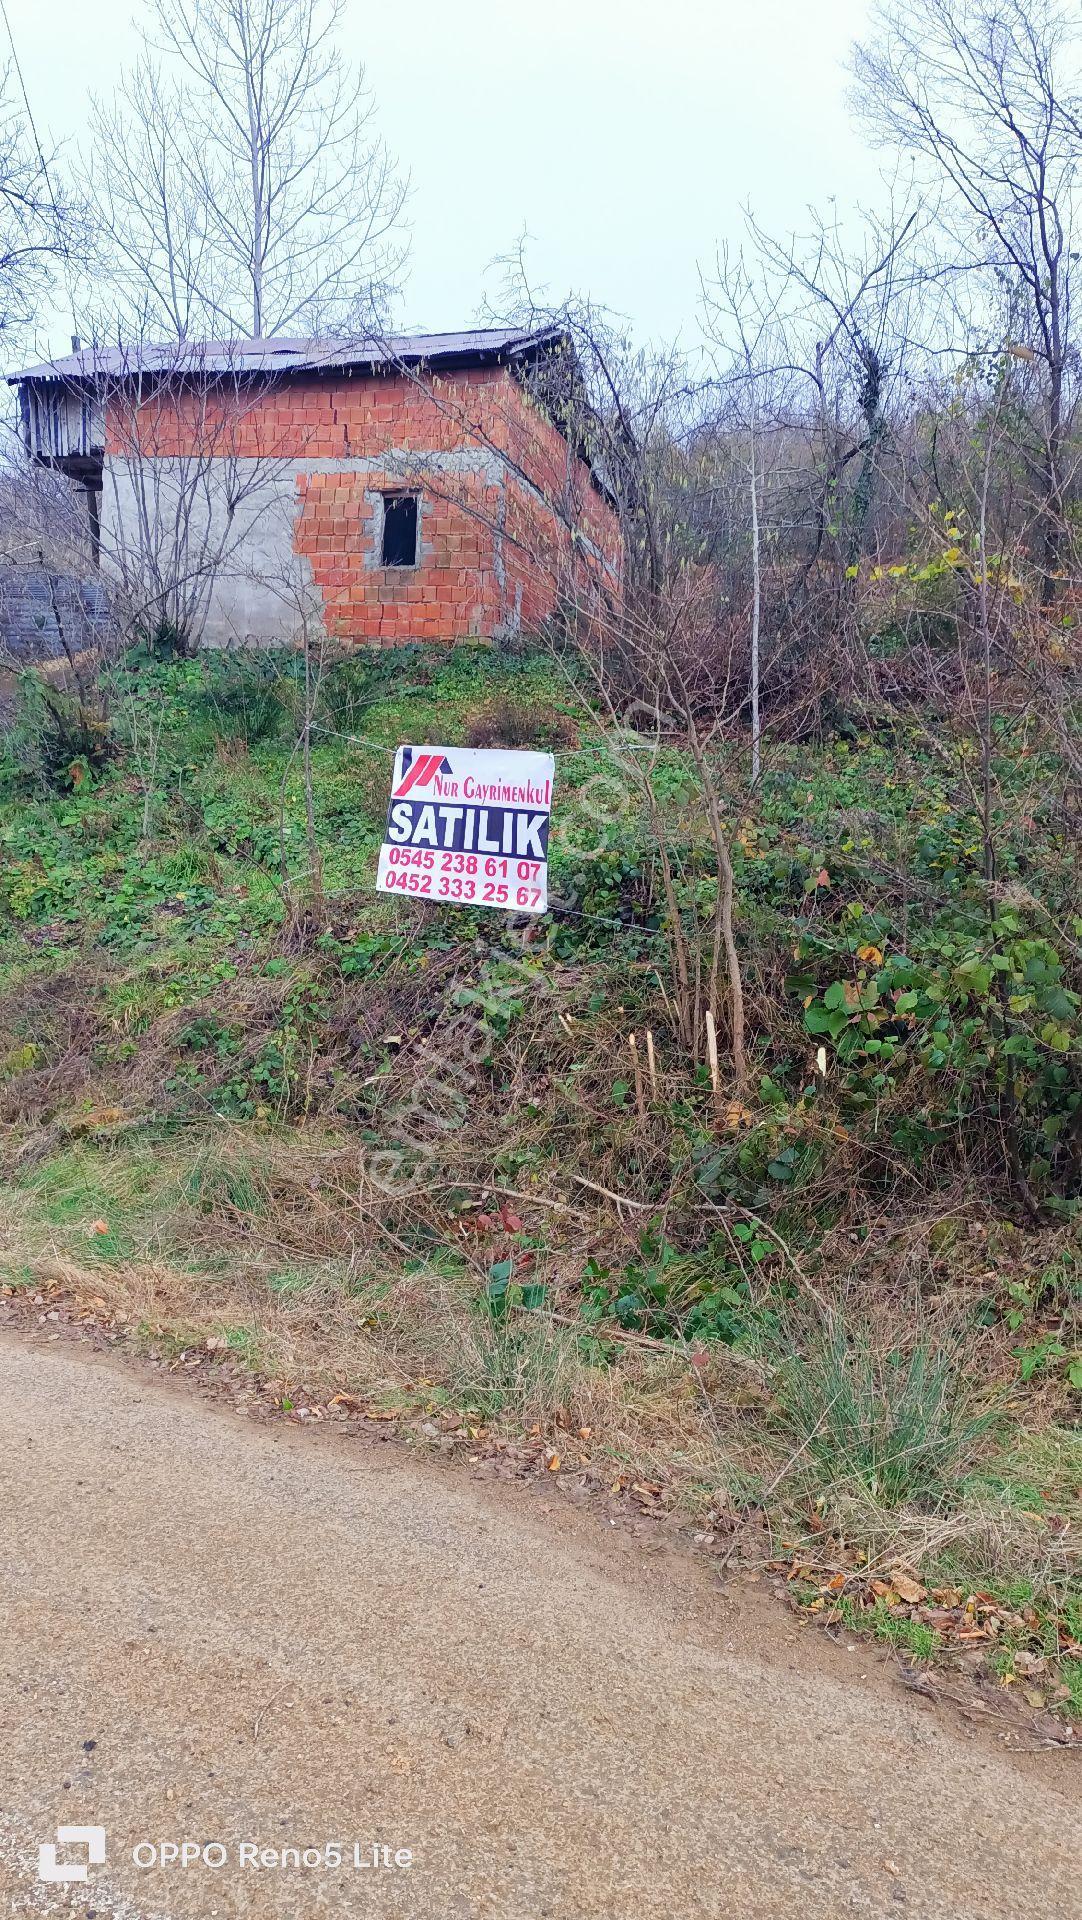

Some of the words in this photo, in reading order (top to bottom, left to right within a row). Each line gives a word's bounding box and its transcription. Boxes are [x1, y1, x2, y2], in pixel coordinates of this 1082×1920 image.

[433, 775, 459, 798] NUR
[388, 803, 548, 858] SATILIK
[389, 847, 435, 869] 0545
[441, 853, 478, 875] 238
[485, 858, 508, 878] 61
[517, 861, 541, 882] 07
[385, 870, 432, 894] 0452
[438, 877, 476, 900] 333
[482, 882, 509, 903] 25
[516, 886, 542, 907] 67
